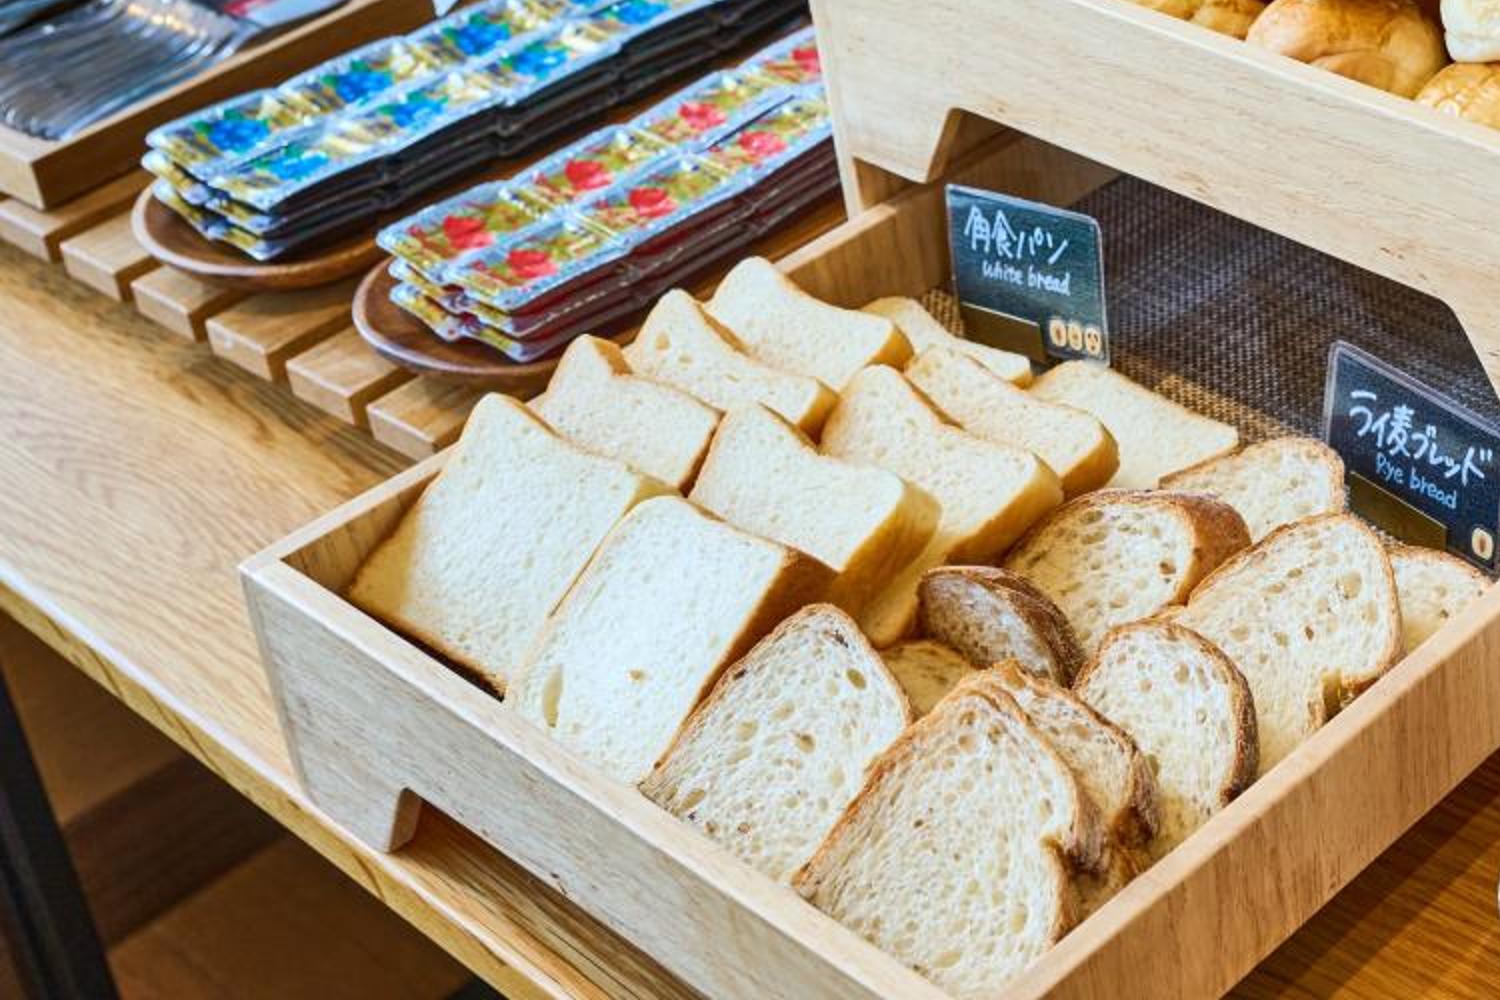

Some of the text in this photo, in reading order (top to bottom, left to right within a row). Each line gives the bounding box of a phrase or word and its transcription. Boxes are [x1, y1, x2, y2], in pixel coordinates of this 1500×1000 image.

[1027, 264, 1072, 297] bread
[1350, 389, 1494, 487] ライ麦ブレッド
[1375, 452, 1457, 510] Rye bread
